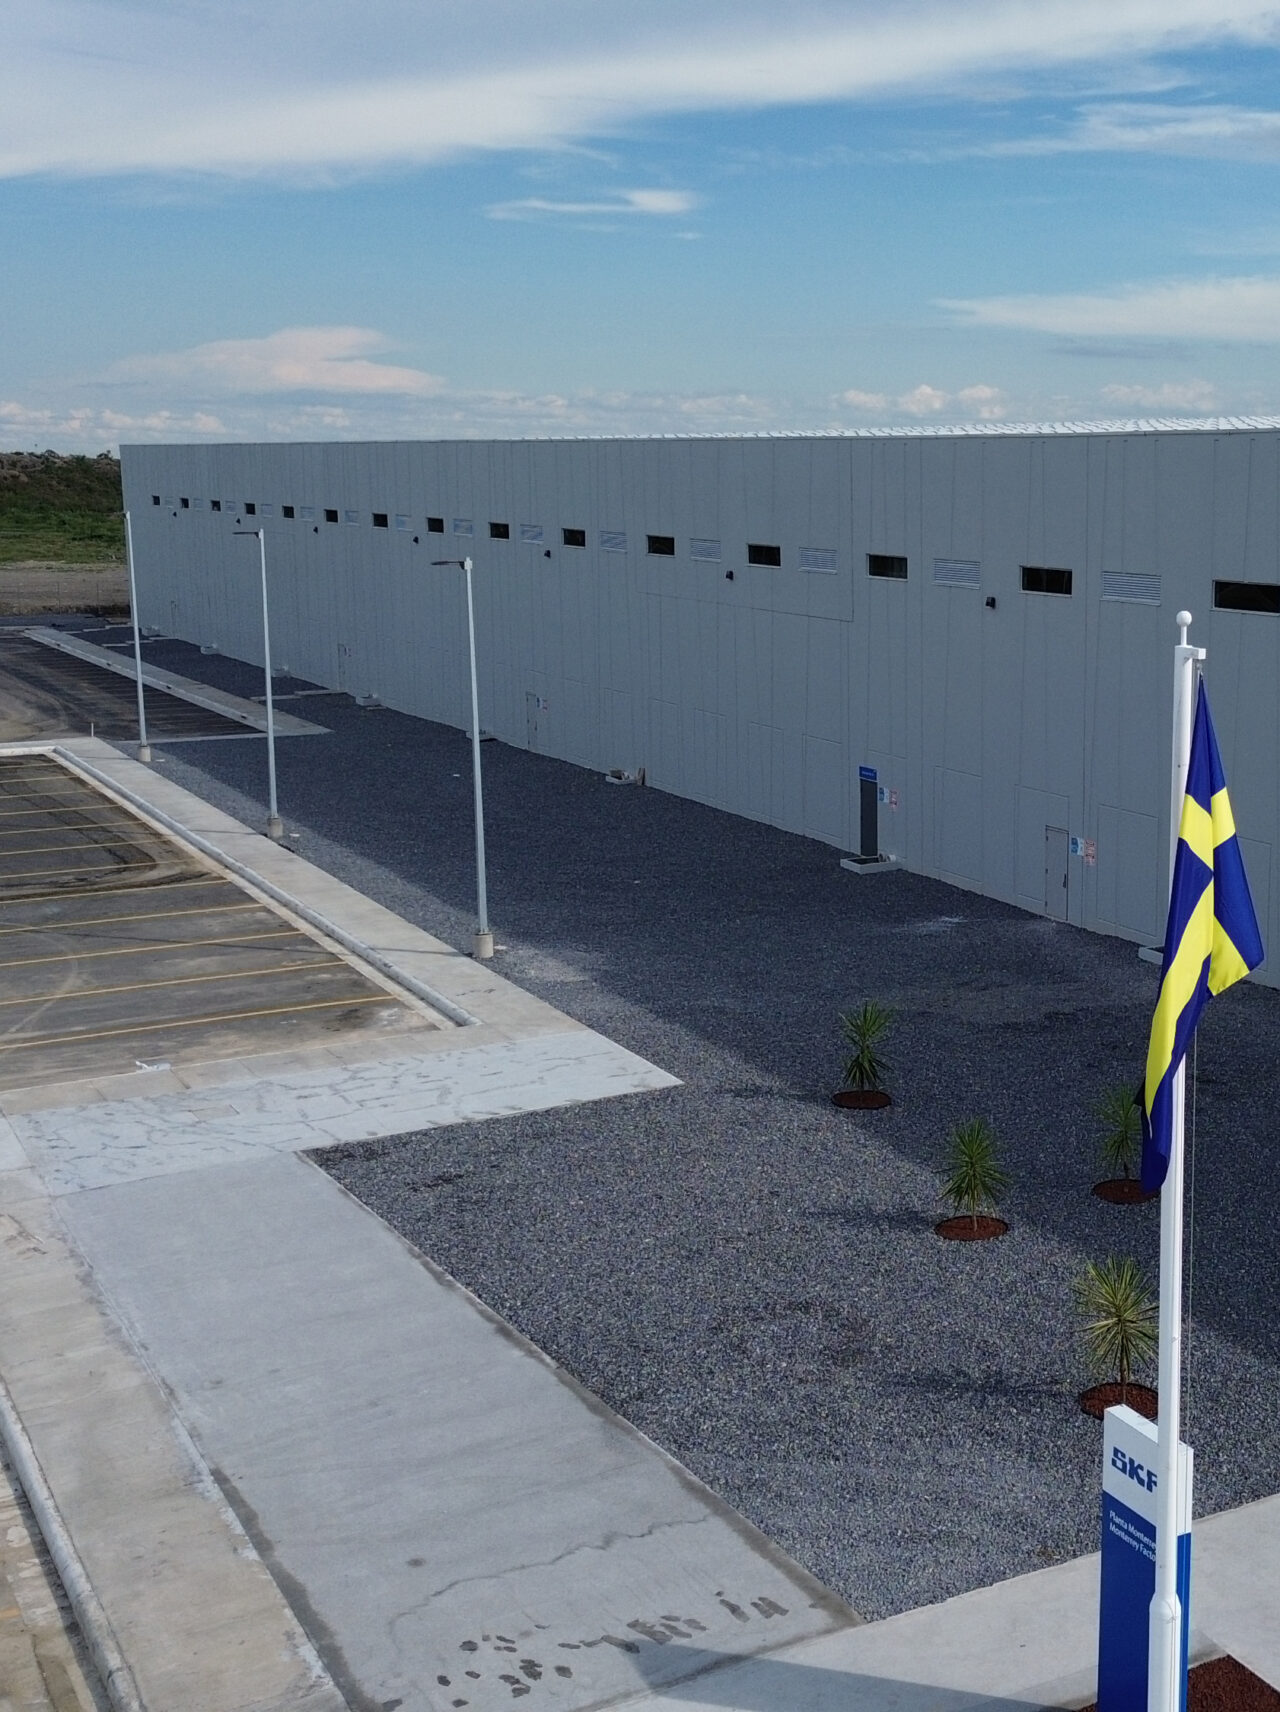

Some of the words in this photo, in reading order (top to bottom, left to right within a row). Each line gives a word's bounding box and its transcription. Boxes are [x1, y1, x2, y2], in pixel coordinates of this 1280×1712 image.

[1111, 1446, 1158, 1493] SKF
[1109, 1510, 1128, 1530] Planta
[1128, 1522, 1156, 1551] Monterre
[1109, 1522, 1140, 1551] Monterrey
[1140, 1543, 1156, 1562] Facto
